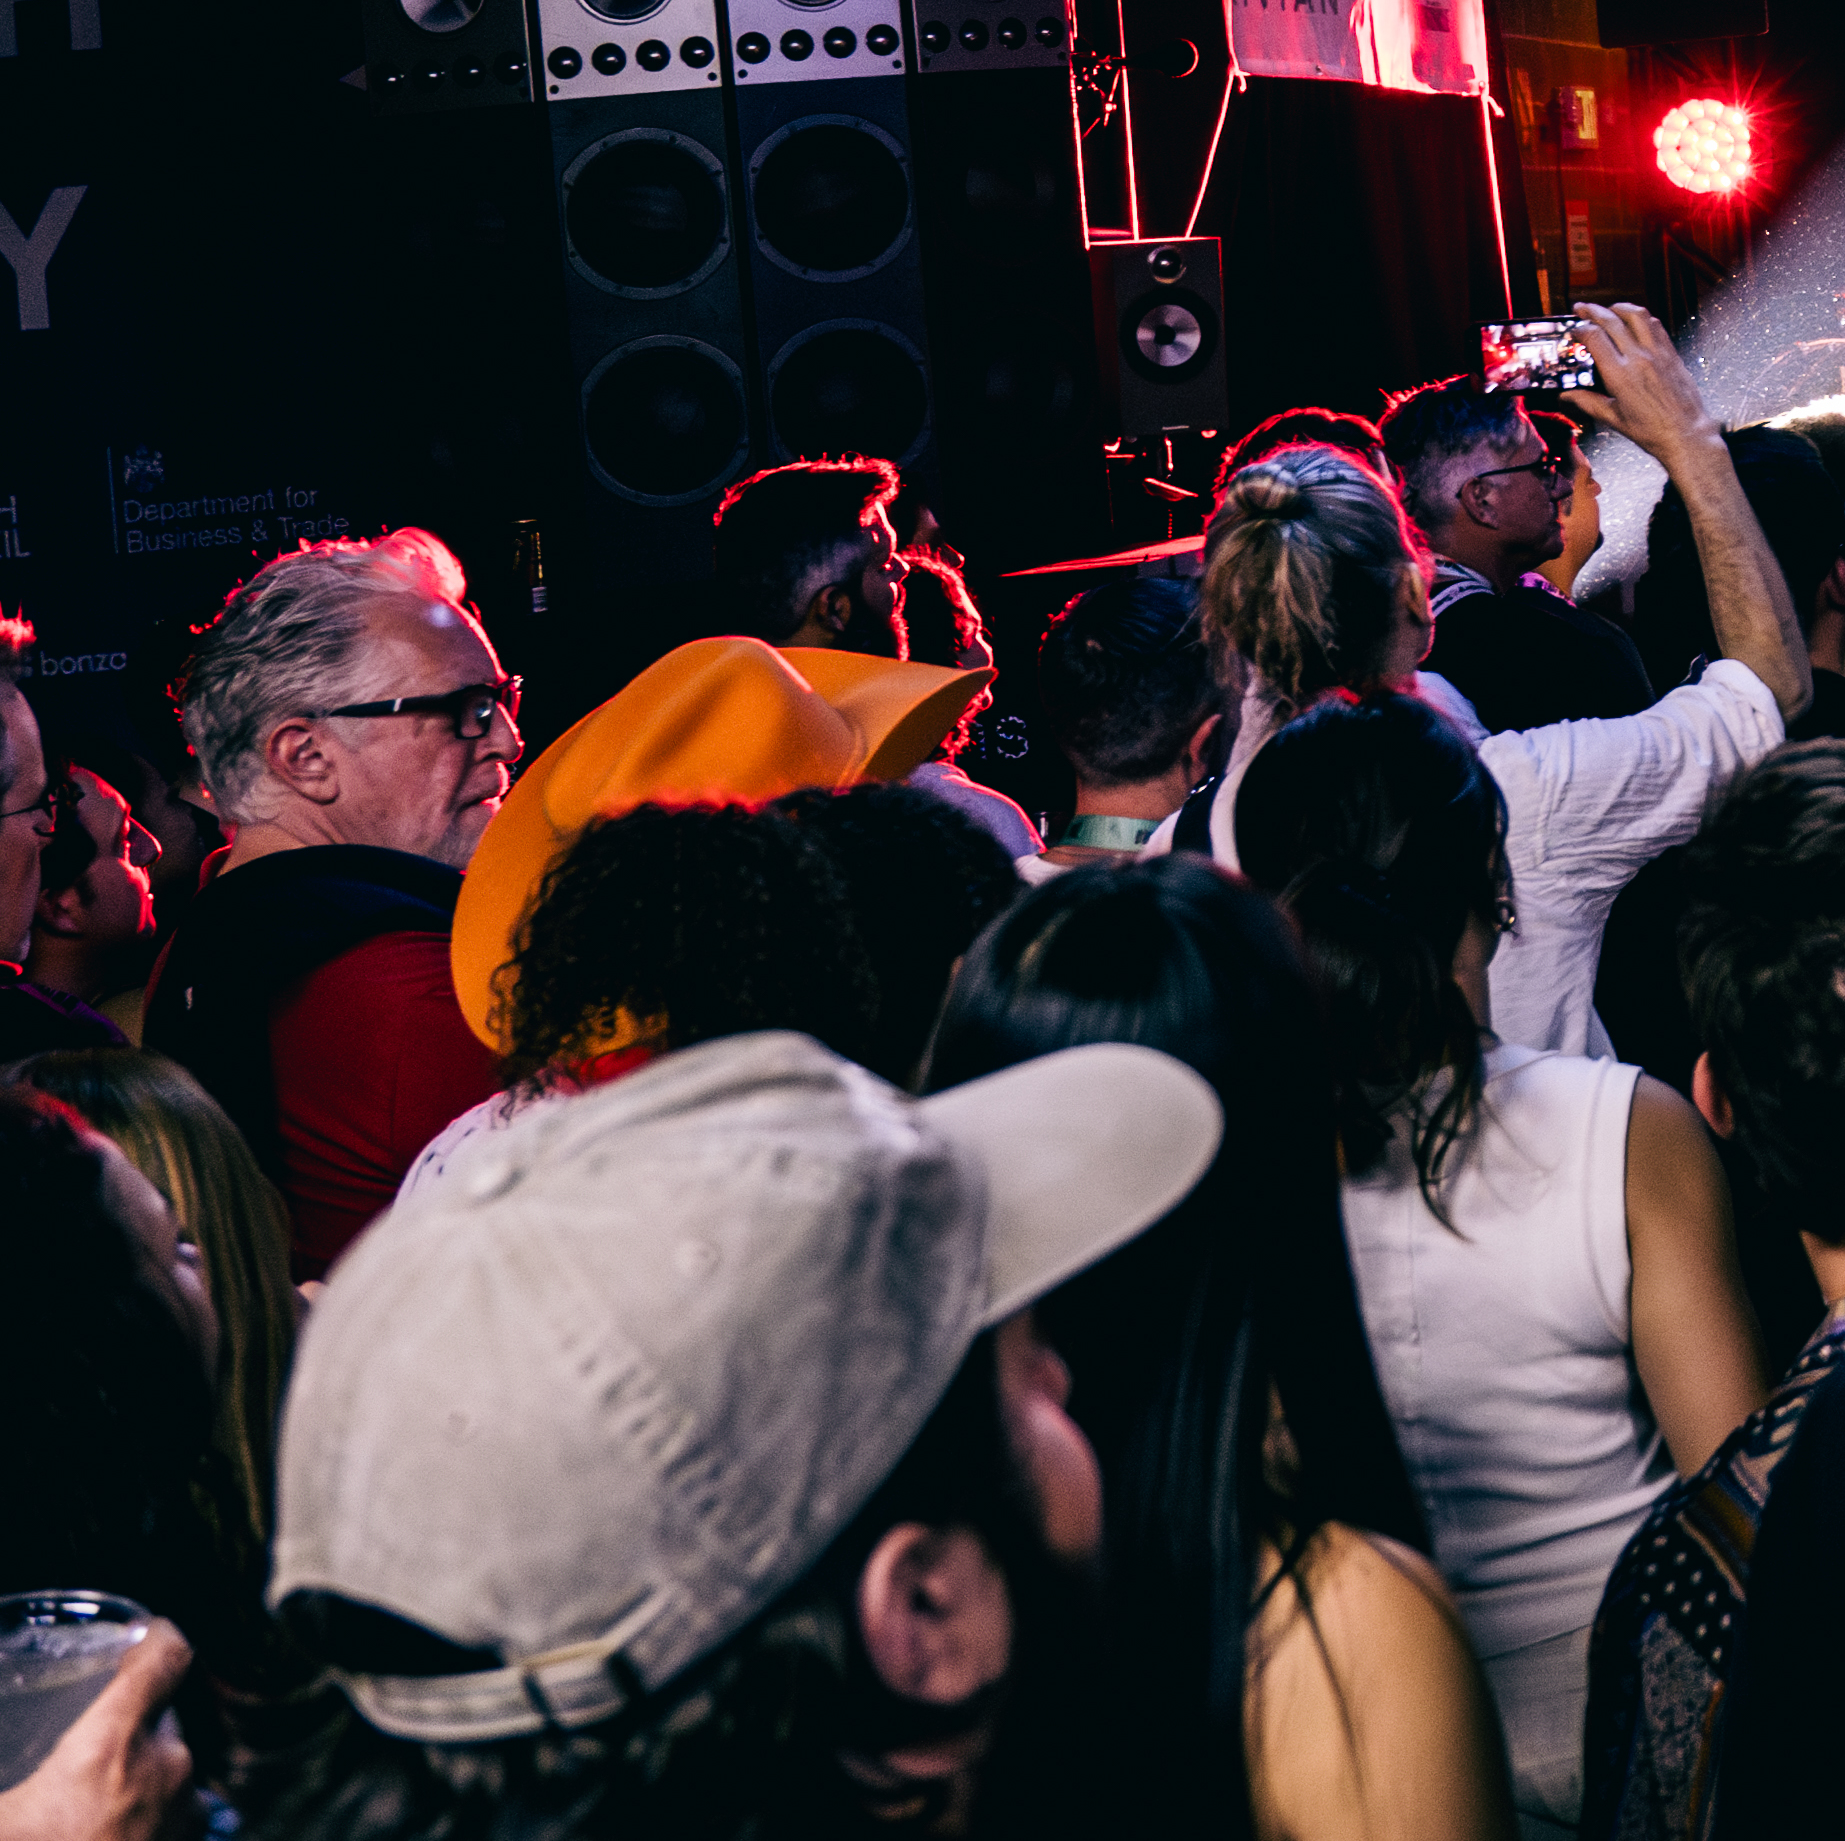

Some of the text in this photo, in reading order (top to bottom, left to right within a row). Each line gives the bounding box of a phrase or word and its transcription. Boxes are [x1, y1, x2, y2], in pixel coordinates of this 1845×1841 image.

[123, 486, 318, 525] Department for
[0, 526, 32, 560] IL
[126, 513, 349, 554] Business & Trade
